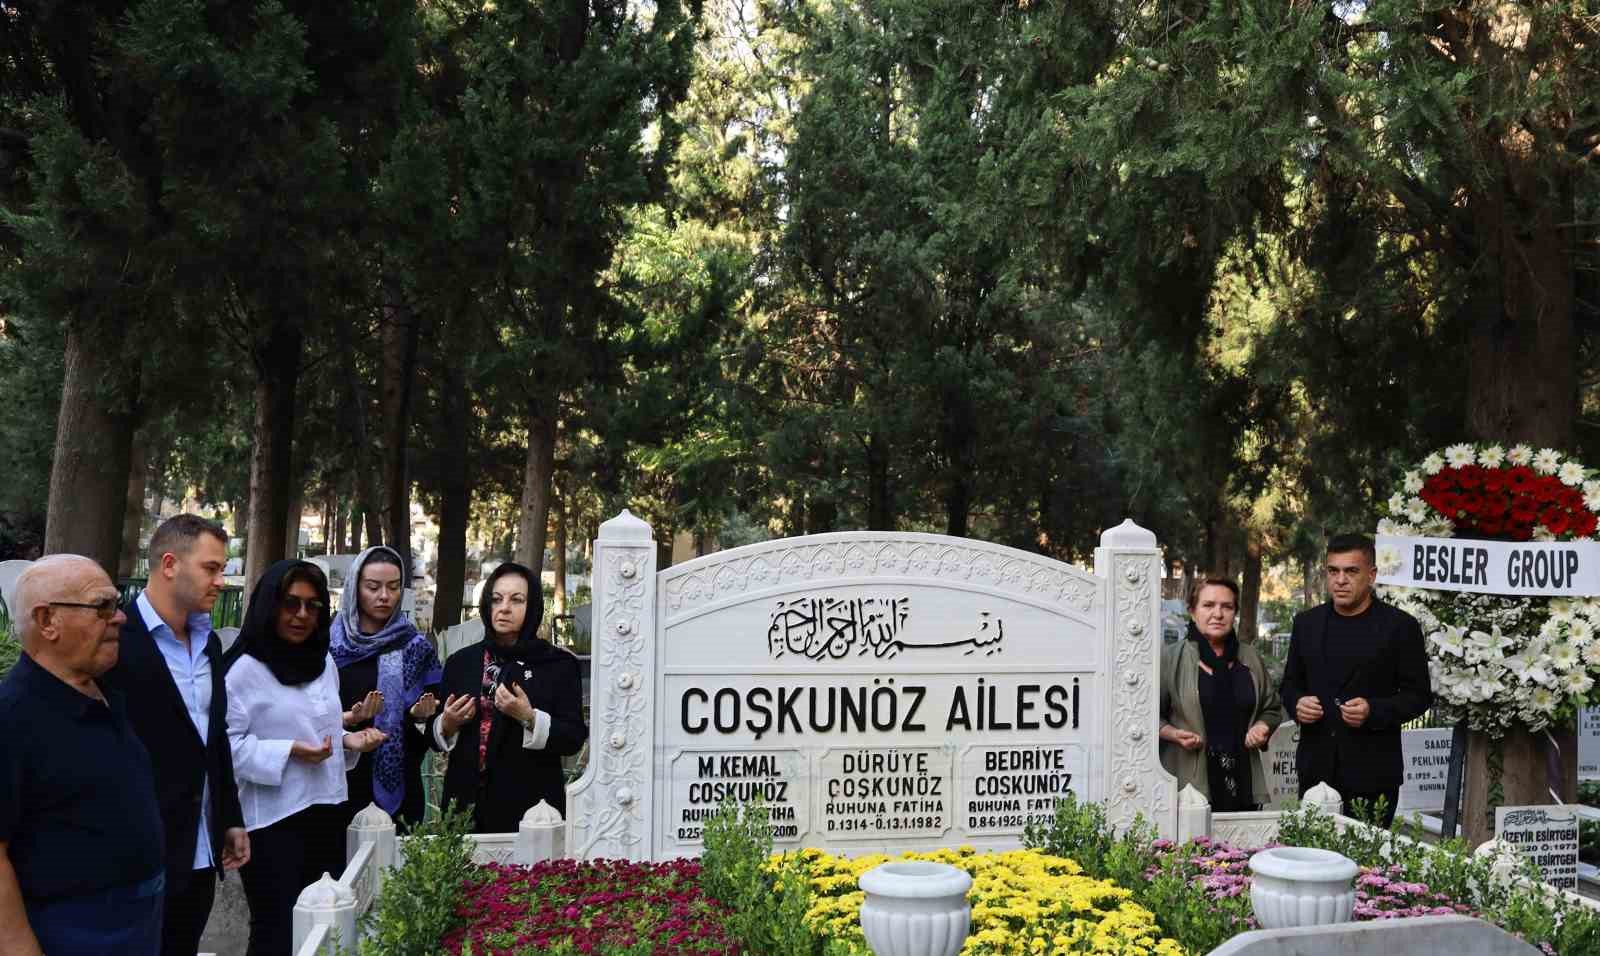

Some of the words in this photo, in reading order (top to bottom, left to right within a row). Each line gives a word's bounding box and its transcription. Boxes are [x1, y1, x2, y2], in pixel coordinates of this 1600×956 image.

[1413, 544, 1489, 586] BESLER
[1508, 549, 1579, 588] GROUP
[681, 678, 927, 740] COŞKUNÖZ
[945, 677, 1081, 732] AİLESİ
[698, 755, 781, 778] M.KEMAL
[843, 749, 928, 774] DÜRÜYE
[985, 746, 1065, 771] BEDRİYE
[826, 802, 886, 815] RUHUNA
[894, 799, 944, 813] FATİHA
[968, 799, 1021, 813] RUHUNA
